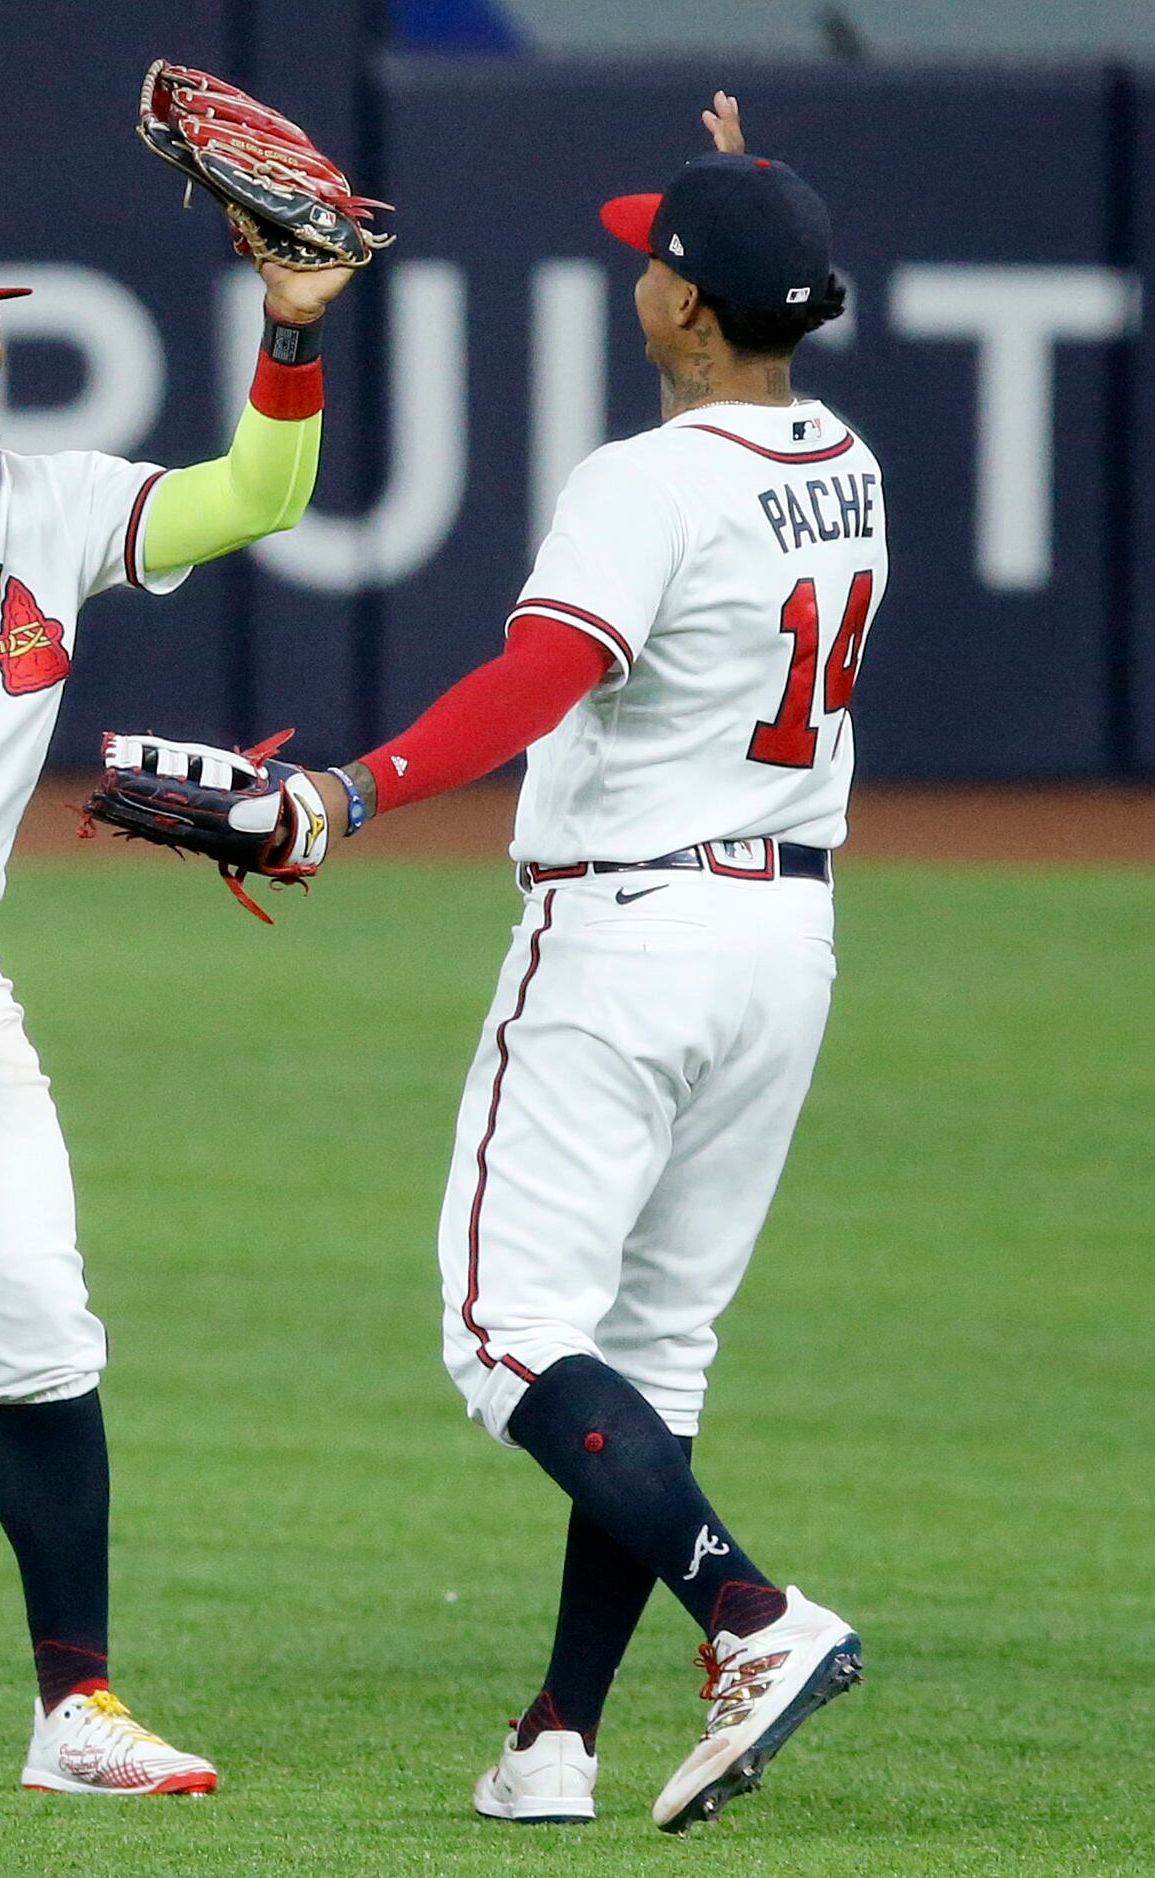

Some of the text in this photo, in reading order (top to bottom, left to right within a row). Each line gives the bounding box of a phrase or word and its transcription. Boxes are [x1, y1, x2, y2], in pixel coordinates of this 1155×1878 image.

[758, 472, 877, 554] PACHE
[746, 568, 874, 769] 14
[683, 1524, 730, 1581] A
